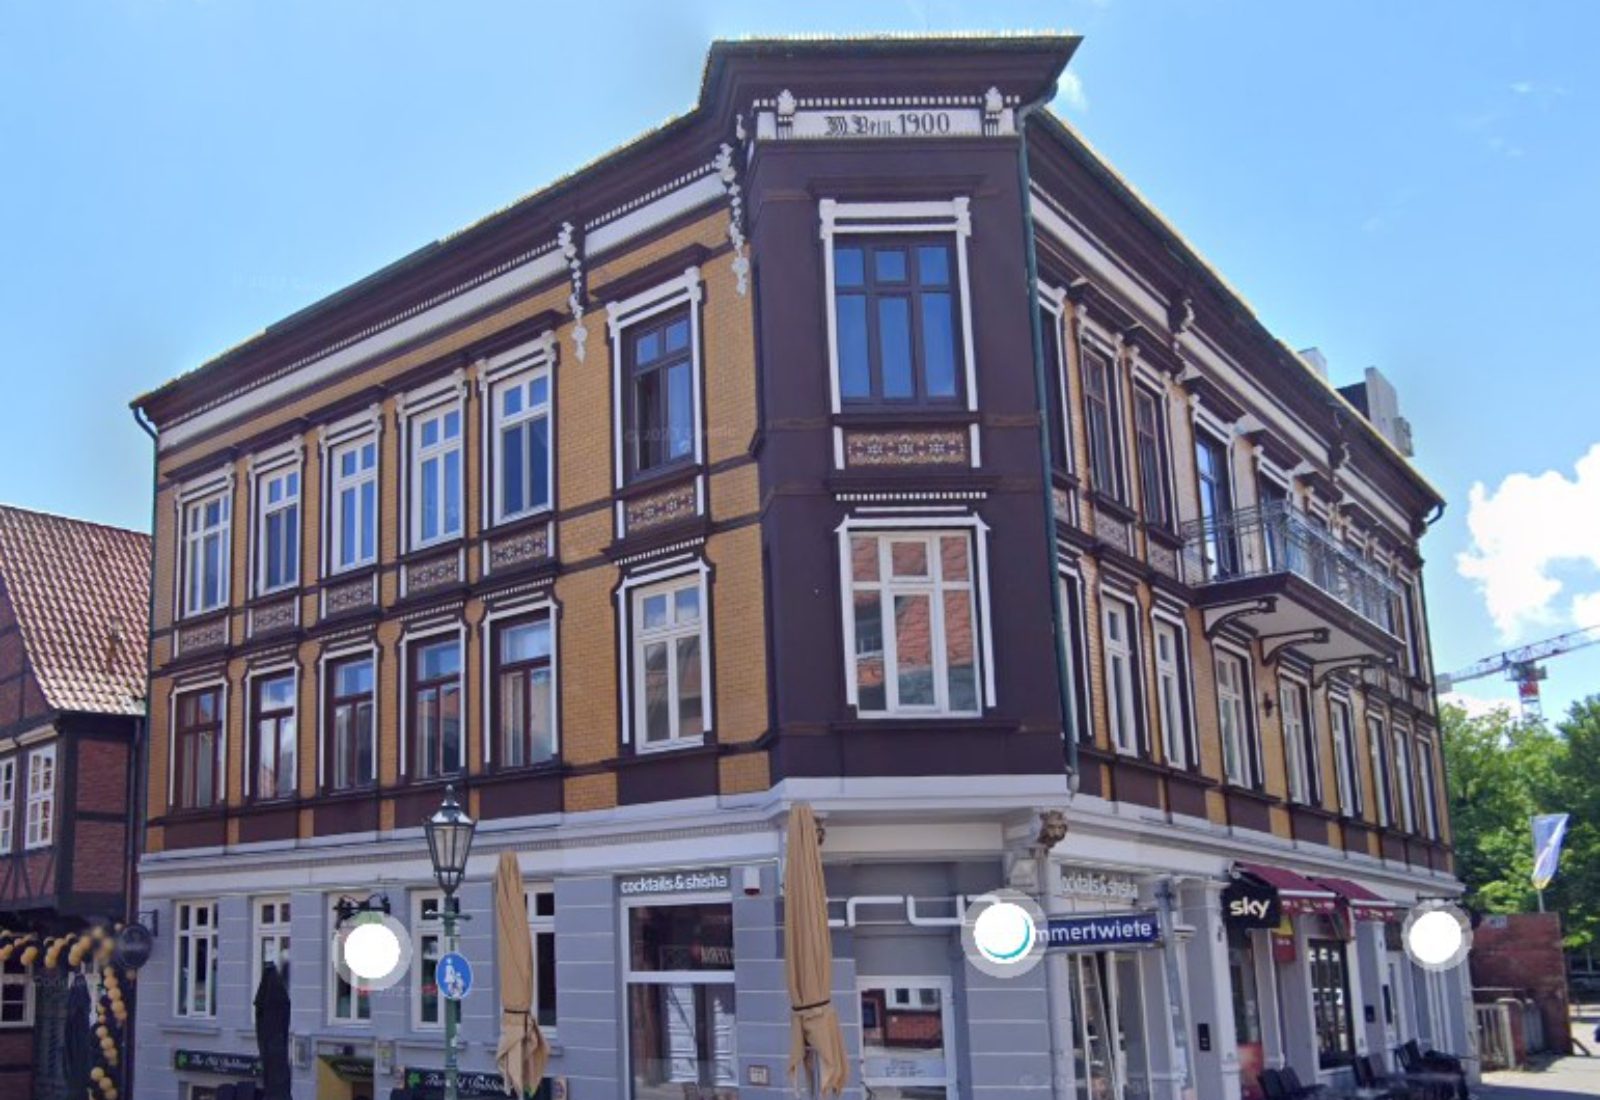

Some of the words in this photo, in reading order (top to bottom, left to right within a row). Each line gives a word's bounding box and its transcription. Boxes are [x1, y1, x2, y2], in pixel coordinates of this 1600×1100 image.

[898, 112, 950, 135] 1900
[1230, 896, 1270, 918] sky
[1034, 920, 1152, 942] mmertwiete
